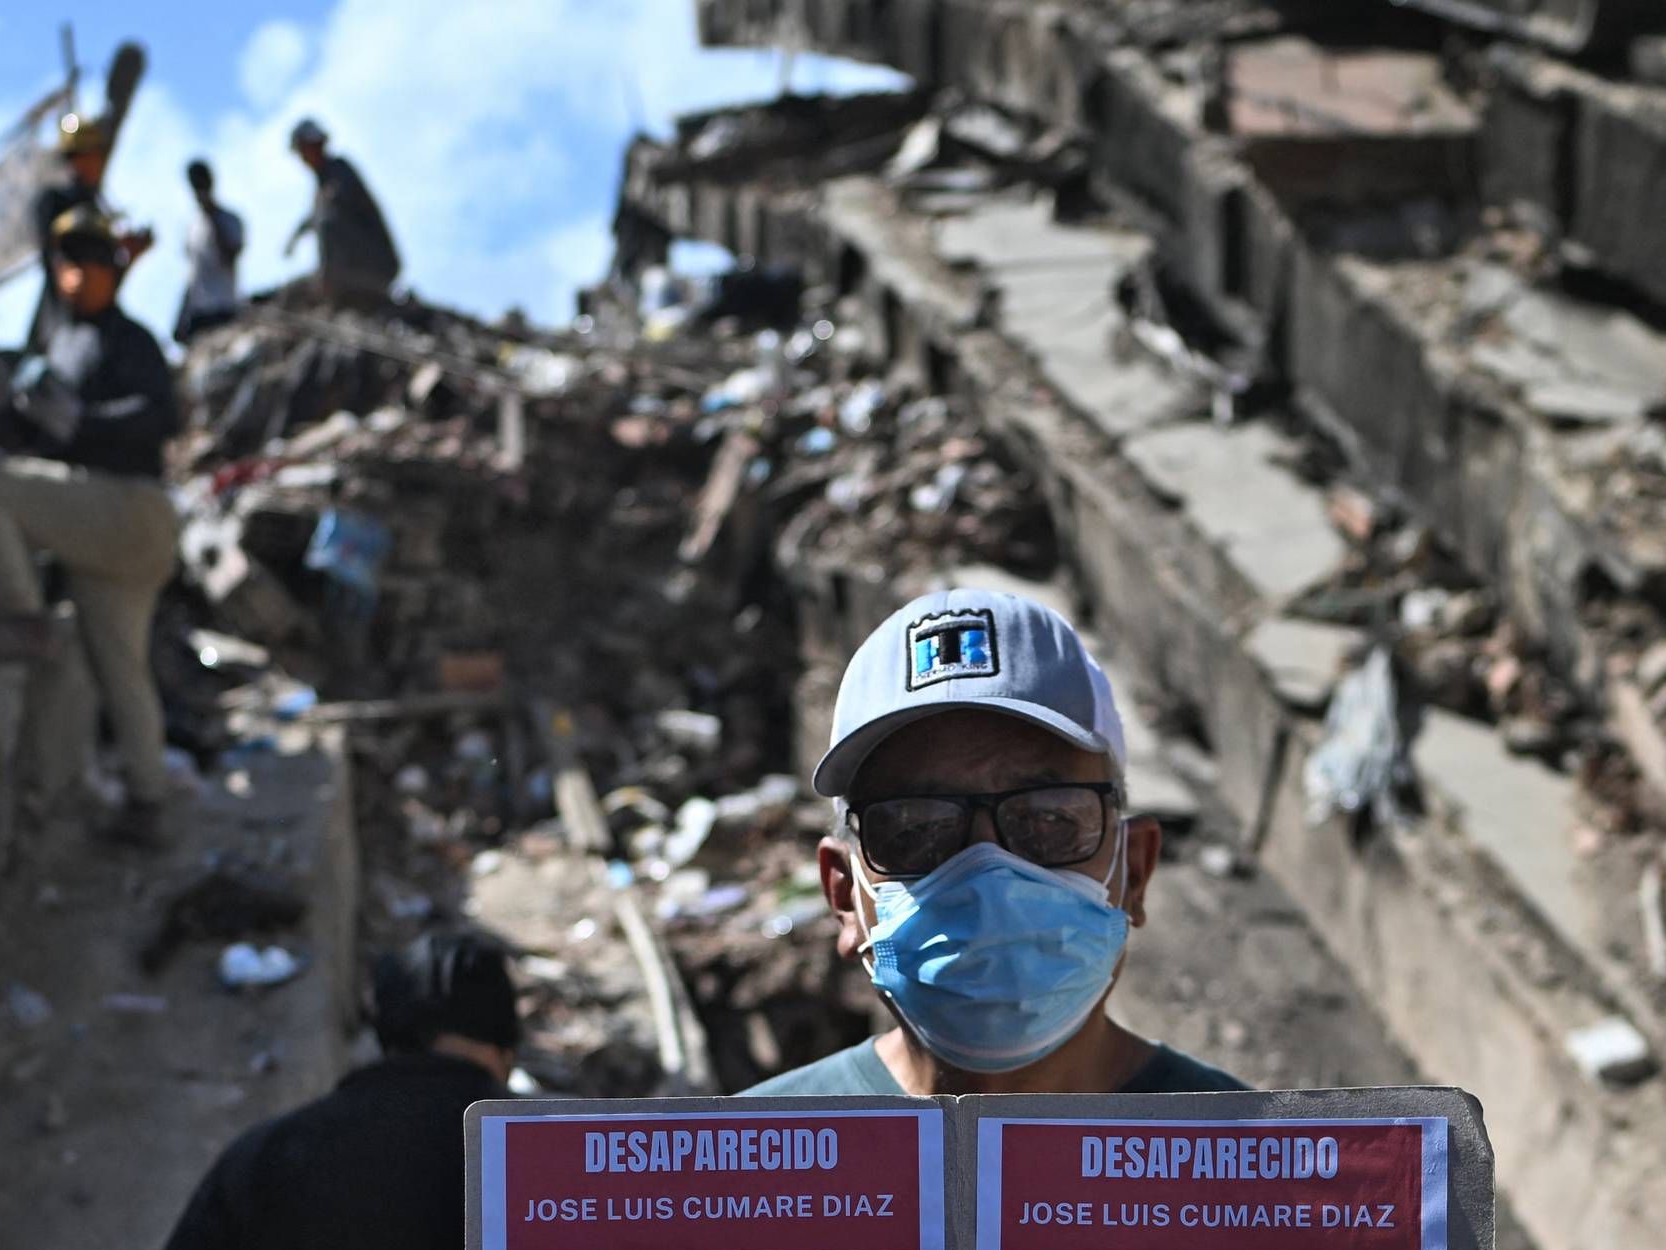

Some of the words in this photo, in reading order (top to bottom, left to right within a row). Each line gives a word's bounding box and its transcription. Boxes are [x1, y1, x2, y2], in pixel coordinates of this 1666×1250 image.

[585, 1128, 838, 1173] DESAPARECIDO
[1081, 1137, 1339, 1180] DESAPARECIDO
[525, 1199, 597, 1221] JOSE
[607, 1198, 674, 1221] LUIS
[683, 1196, 813, 1220] CUMARE
[823, 1194, 894, 1218] DIAZ
[1020, 1202, 1093, 1226] JOSE
[1103, 1203, 1171, 1226] LUIS
[1180, 1204, 1311, 1228] CUMARE
[1321, 1205, 1395, 1228] DIAZ
